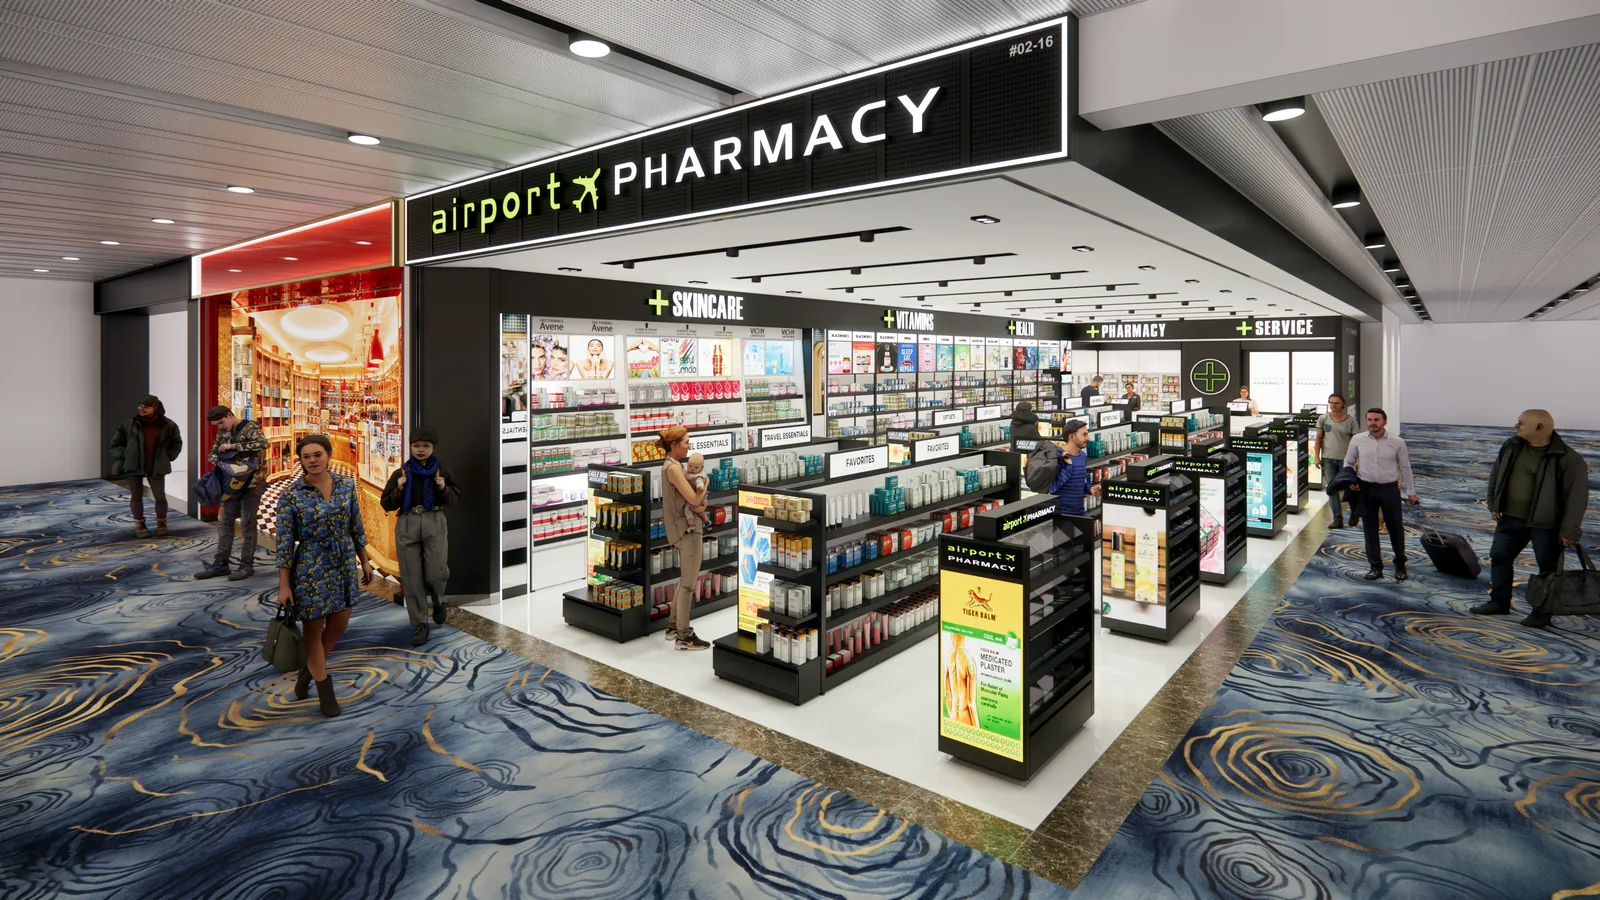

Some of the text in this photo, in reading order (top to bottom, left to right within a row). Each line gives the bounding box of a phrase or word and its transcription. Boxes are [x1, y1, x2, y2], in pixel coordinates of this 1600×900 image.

[1008, 35, 1054, 58] #02-16
[431, 86, 942, 234] airport PHARMACY
[672, 291, 744, 321] SKINCARE
[896, 310, 934, 331] VITAMINS
[1255, 319, 1313, 336] SERVICE
[1101, 323, 1166, 338] PHARMACY
[764, 430, 809, 442] TRAVEL ESSENTIALS
[696, 439, 729, 450] ESSENTIALS
[927, 442, 950, 453] FAVORITES
[845, 454, 875, 468] FAVORITES
[1175, 460, 1211, 468] airport
[1175, 466, 1220, 474] PHARMACY
[1108, 485, 1149, 496] airport
[1108, 493, 1160, 503] PHARMACY
[1002, 505, 1056, 531] airport PHARMACY
[947, 545, 1002, 560] airport
[947, 555, 1016, 572] PHARMACY
[962, 608, 996, 621] TIGER BALM
[983, 633, 995, 641] COOL
[980, 653, 1013, 668] MEDICATED
[980, 661, 1006, 674] PLASTER
